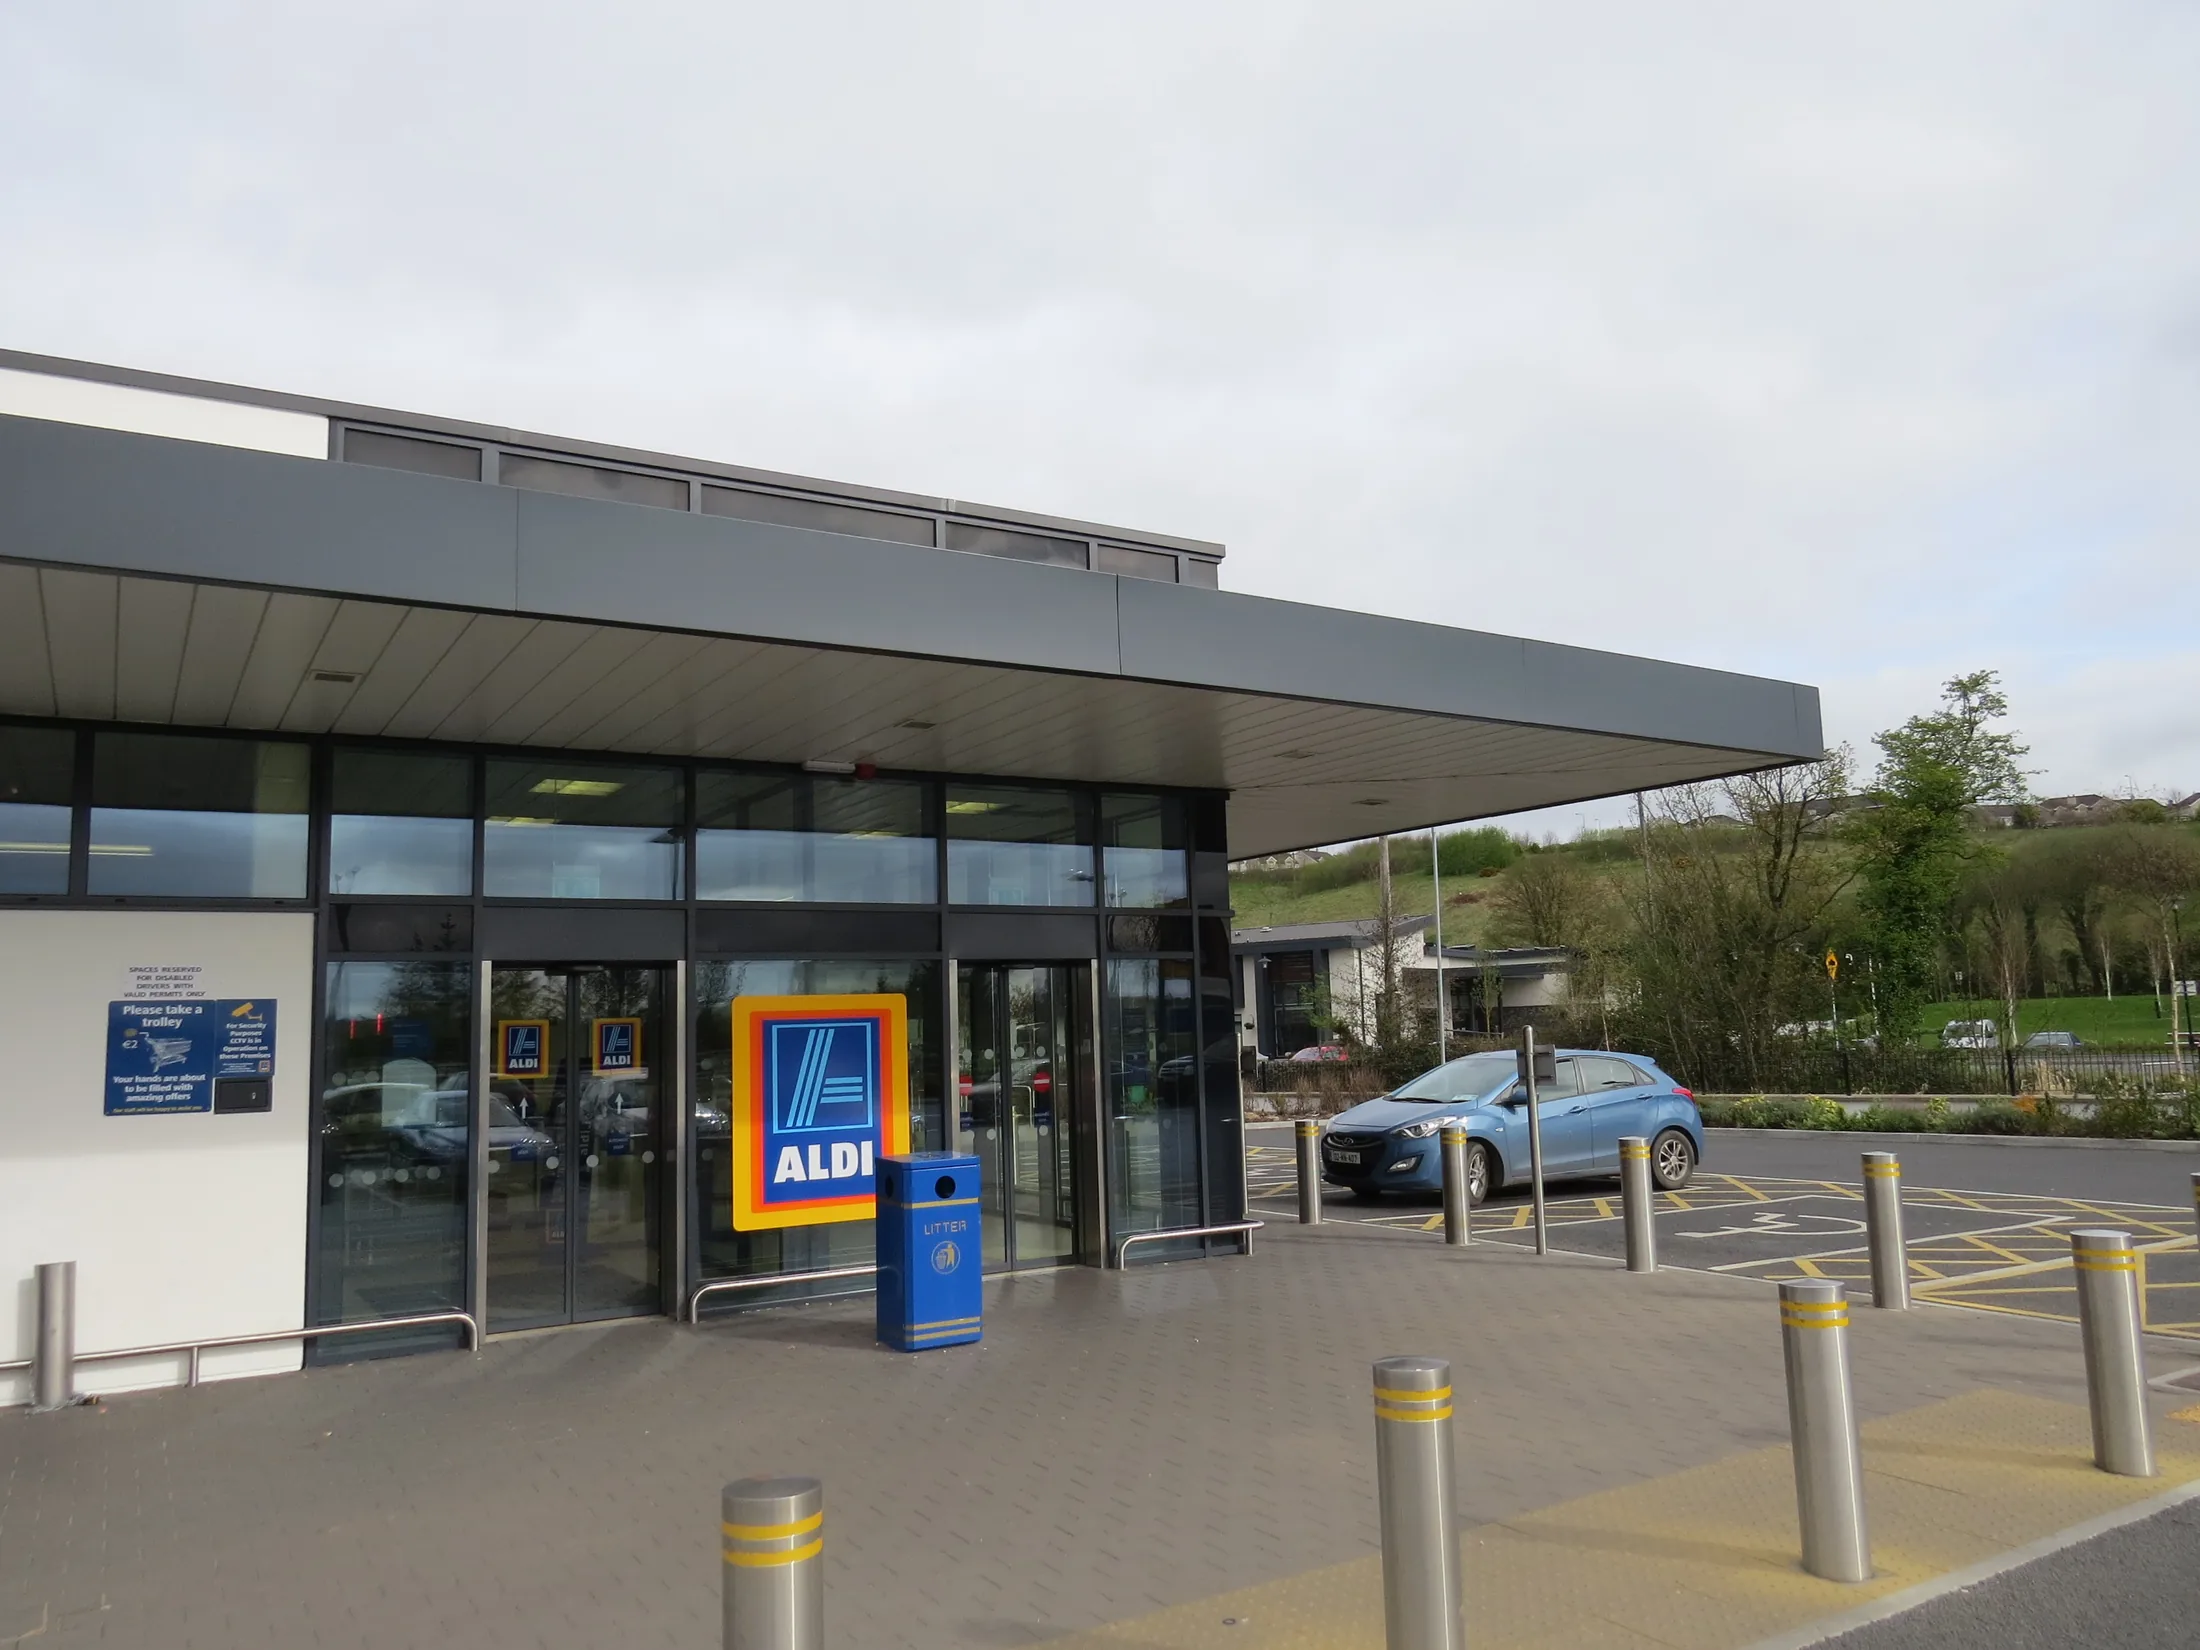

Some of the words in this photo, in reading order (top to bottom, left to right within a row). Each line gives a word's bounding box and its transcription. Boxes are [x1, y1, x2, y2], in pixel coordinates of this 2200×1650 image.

[123, 1004, 163, 1014] Please
[166, 1004, 192, 1014] take
[194, 1006, 203, 1015] a
[142, 1016, 183, 1029] trolley
[122, 1040, 138, 1049] €2
[223, 1045, 258, 1053] Operation
[509, 1058, 538, 1069] ALDI
[602, 1055, 631, 1066] ALDI
[135, 1074, 162, 1082] hands
[180, 1073, 206, 1081] about
[136, 1084, 148, 1092] be
[149, 1083, 172, 1092] filled
[173, 1083, 193, 1091] with
[126, 1093, 163, 1103] amazing
[165, 1092, 191, 1101] offers
[773, 1140, 874, 1184] ALDI
[924, 1220, 967, 1236] LITTER
